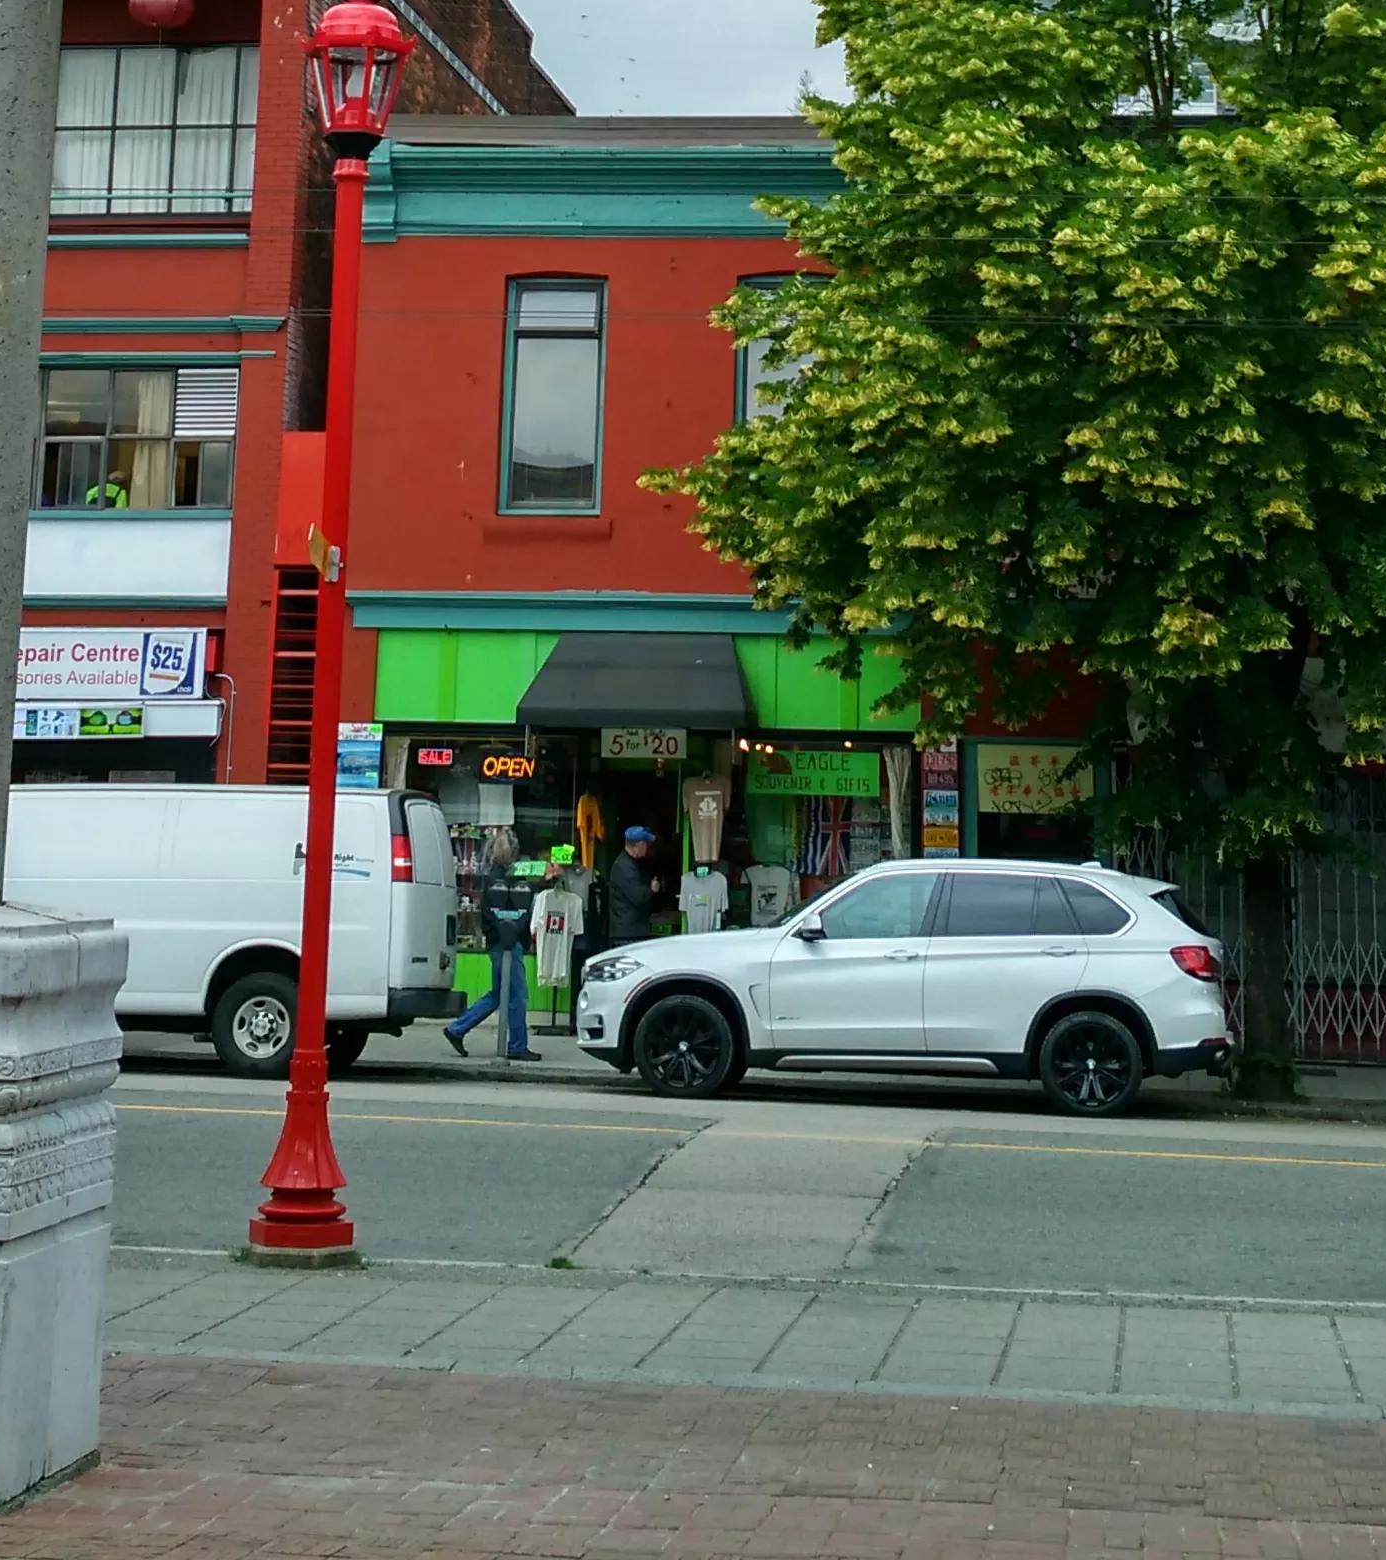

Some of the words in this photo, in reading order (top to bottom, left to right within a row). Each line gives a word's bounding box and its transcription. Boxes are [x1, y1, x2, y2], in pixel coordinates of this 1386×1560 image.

[15, 643, 66, 666] epair
[71, 643, 140, 663] Centre
[16, 671, 63, 686] sories
[66, 670, 138, 686] Available
[609, 734, 624, 755] 5
[625, 738, 640, 751] for
[419, 750, 451, 763] SALE
[796, 752, 851, 772] EAGLE
[482, 756, 535, 778] OPEN
[755, 775, 812, 791] SOUVENIR
[836, 777, 870, 793] GIFTS
